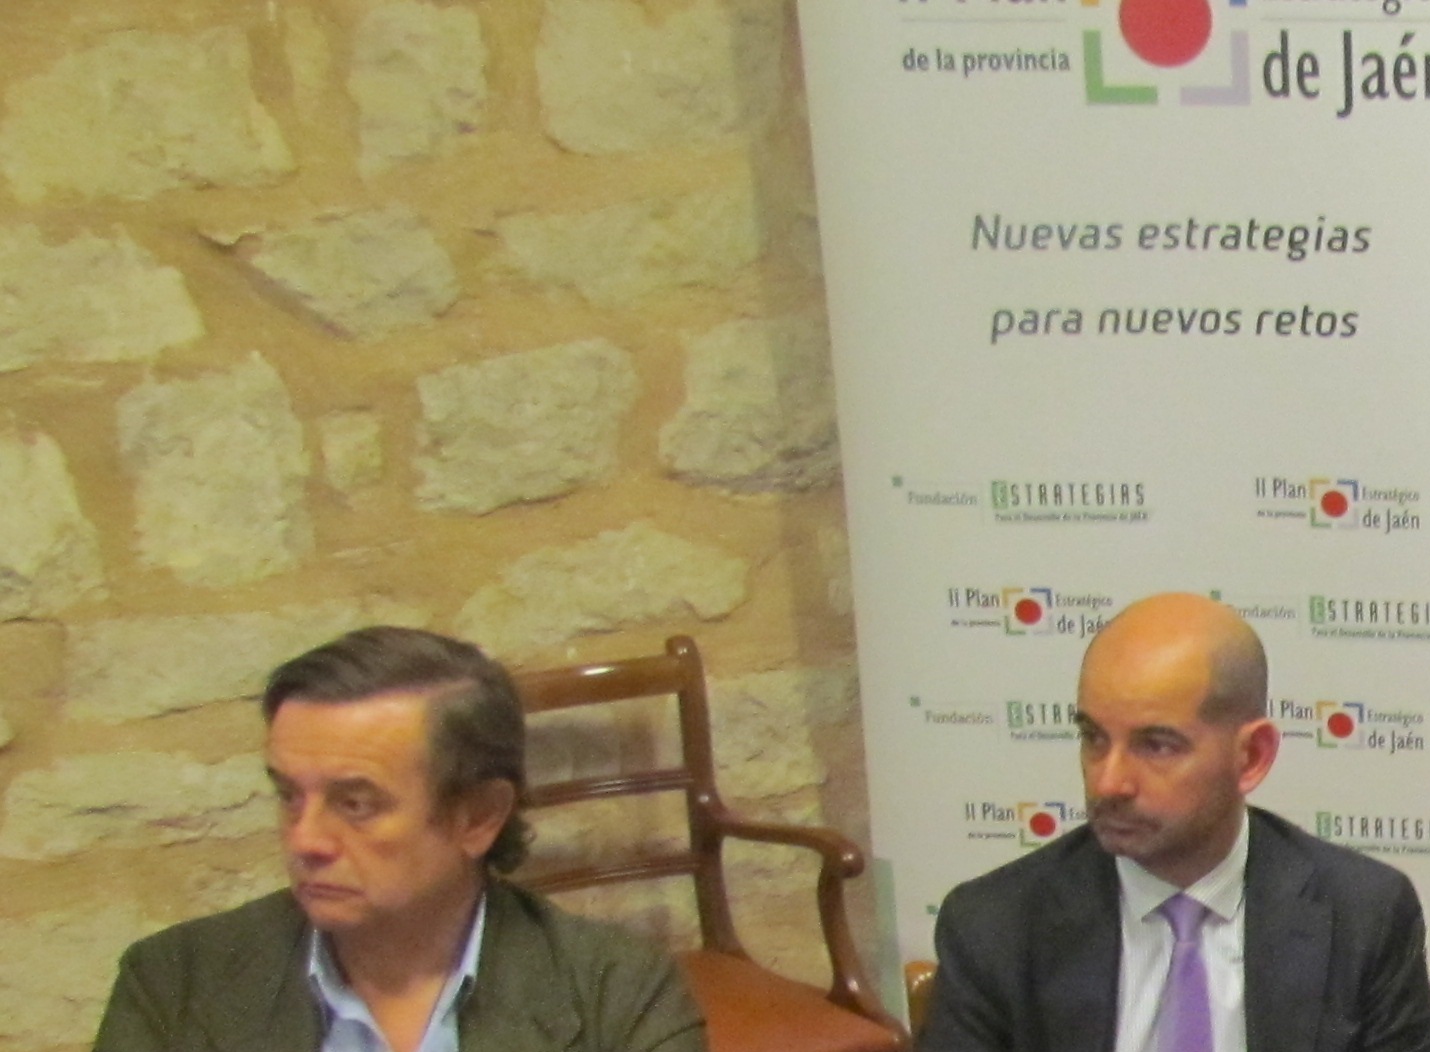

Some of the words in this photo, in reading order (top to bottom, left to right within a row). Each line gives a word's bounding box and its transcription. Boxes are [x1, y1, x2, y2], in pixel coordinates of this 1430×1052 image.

[902, 48, 929, 72] de
[936, 47, 956, 72] la
[962, 48, 1070, 77] provincia
[1262, 29, 1320, 99] de
[971, 215, 1123, 253] Nuevas
[1137, 217, 1372, 261] estrategias
[990, 306, 1084, 344] para
[1098, 306, 1242, 338] nuevos
[1255, 305, 1359, 338] retos
[992, 480, 1145, 509] ESTRATEGIAS
[1273, 478, 1306, 498] Plan
[1363, 509, 1380, 527] de
[1385, 509, 1420, 533] Jaén
[966, 588, 999, 608] Plan
[1057, 614, 1075, 634] de
[1281, 700, 1313, 719] Plan
[1368, 730, 1385, 748] de
[1390, 730, 1424, 754] Jaén
[982, 802, 1015, 821] Plan
